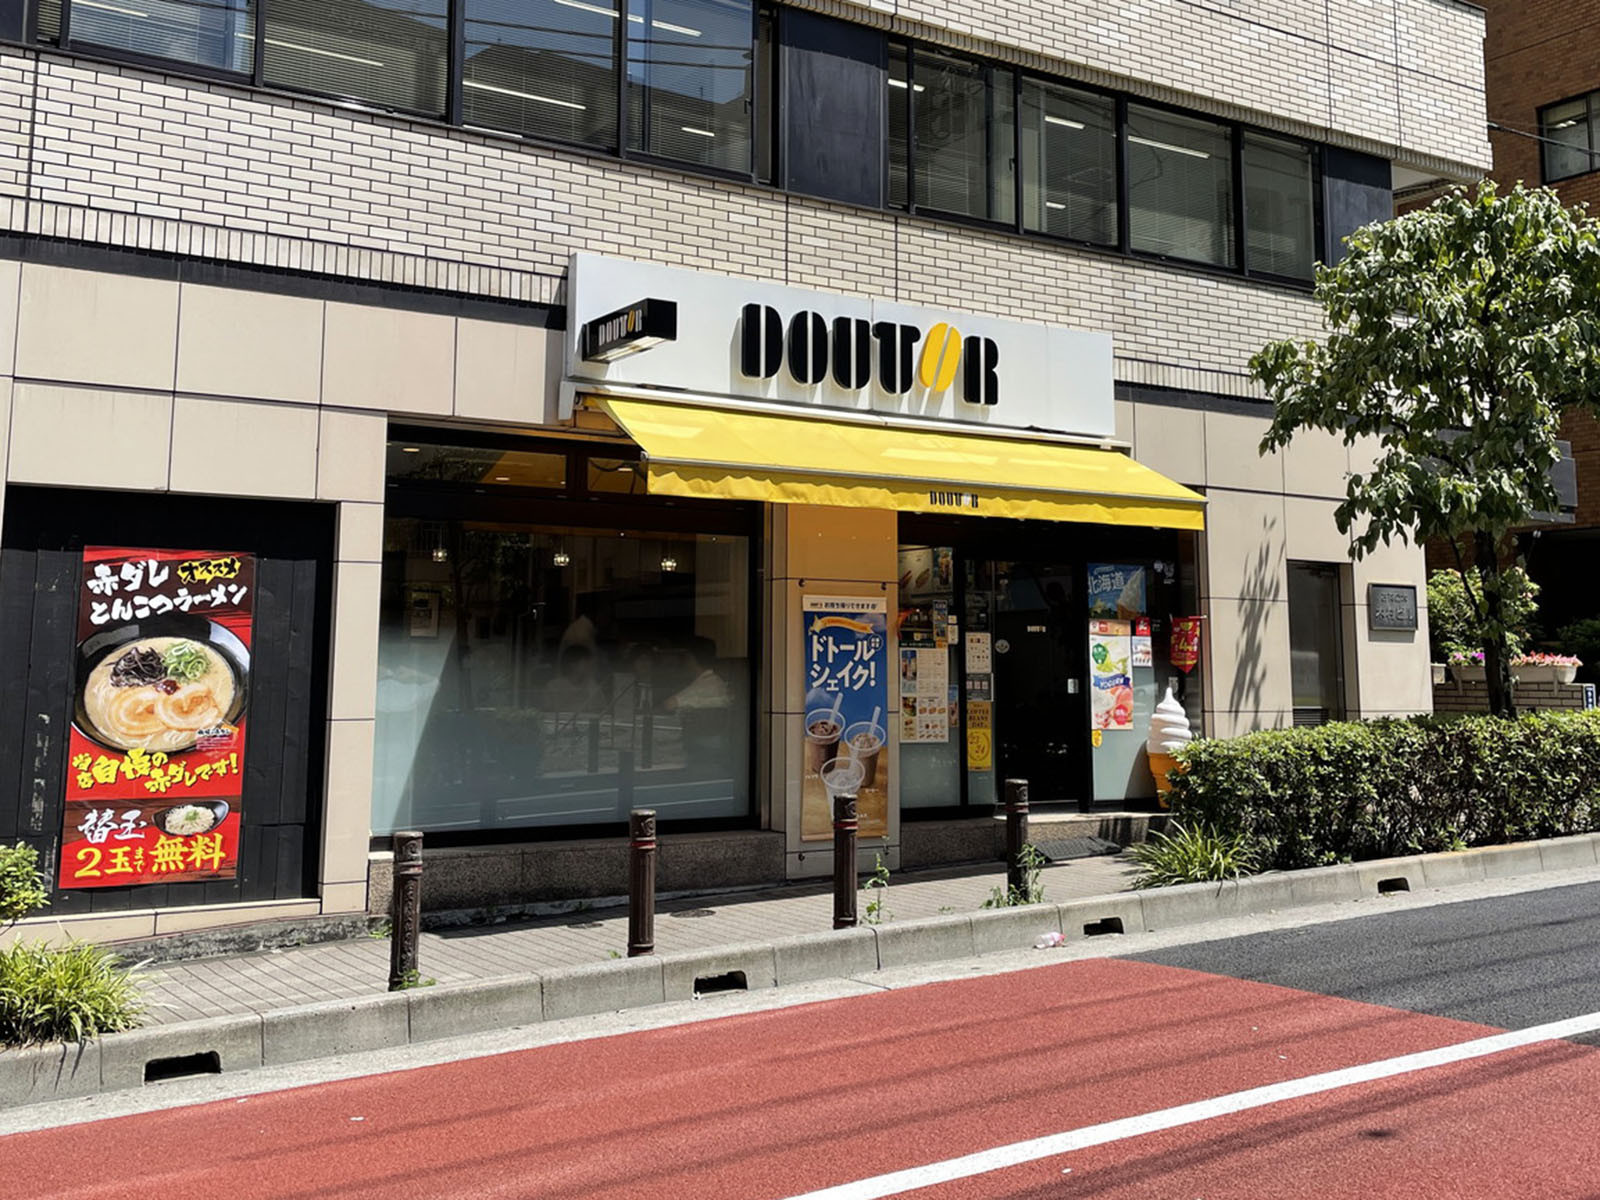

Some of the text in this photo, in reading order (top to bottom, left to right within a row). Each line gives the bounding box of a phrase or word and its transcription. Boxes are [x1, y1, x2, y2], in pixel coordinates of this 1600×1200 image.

[598, 308, 643, 347] DOUTOR
[741, 302, 999, 406] DOUTOR
[929, 490, 979, 508] DOUTOR
[86, 558, 170, 597] 赤ダレ
[180, 557, 237, 582] オススメ
[89, 583, 248, 625] とんこつラーメン
[812, 634, 876, 664] ドトール
[809, 660, 877, 692] シェイク!
[77, 808, 147, 844] 替玉
[74, 832, 226, 878] 2玉まで無料
